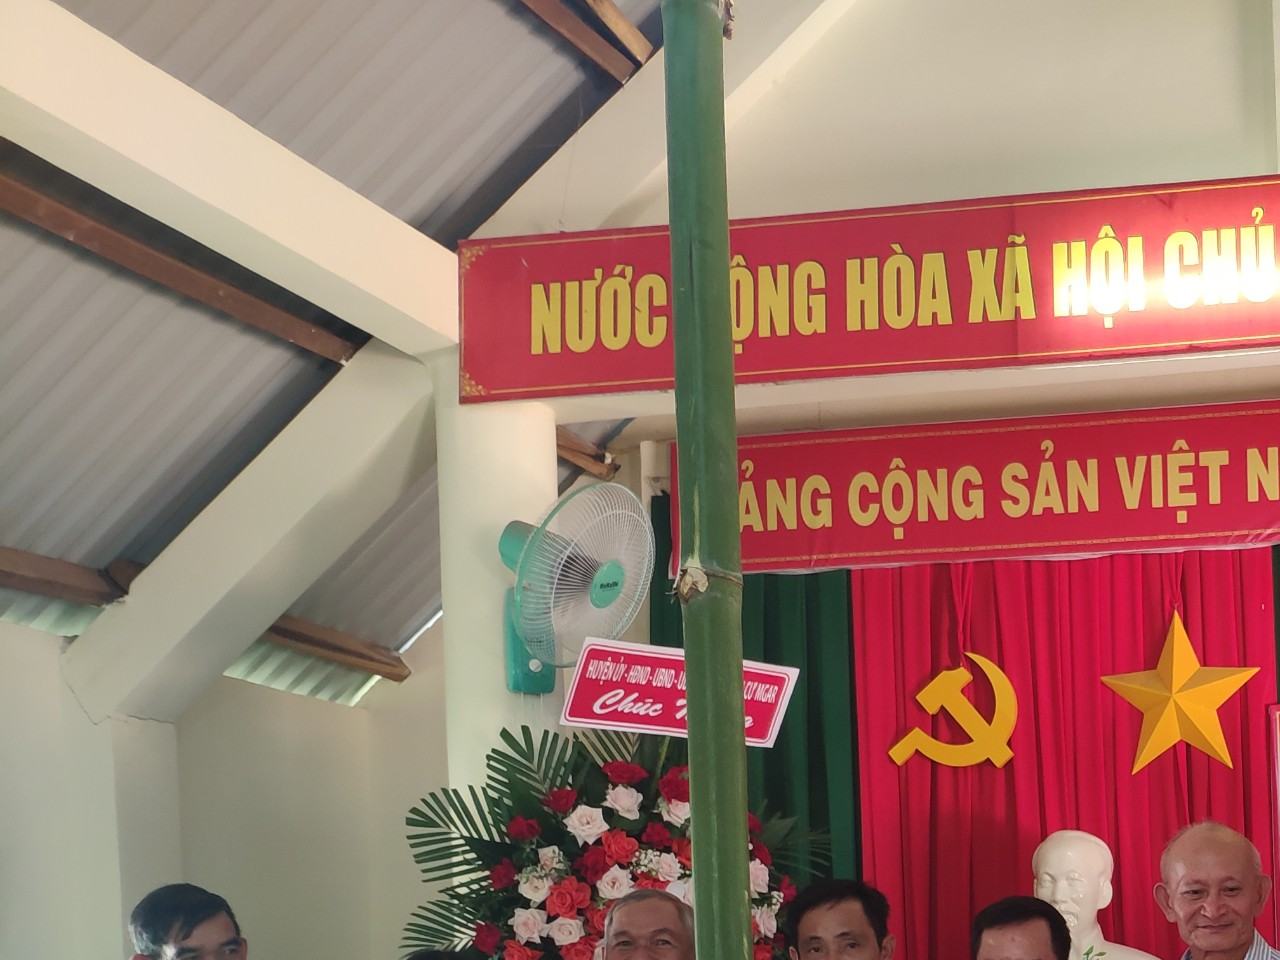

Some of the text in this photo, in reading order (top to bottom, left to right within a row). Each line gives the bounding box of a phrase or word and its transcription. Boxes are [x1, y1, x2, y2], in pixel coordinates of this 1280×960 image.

[530, 264, 668, 355] NƯỚC
[729, 254, 827, 355] ỘNG
[846, 243, 953, 332] HÒA
[966, 234, 1036, 322] XÃ
[1053, 224, 1147, 329] HỘI
[1163, 207, 1278, 310] CHỦ
[739, 460, 833, 534] ẢNG
[848, 457, 985, 540] CỘNG
[1000, 439, 1100, 519] SẢN
[1115, 439, 1230, 524] VIỆT
[586, 656, 614, 685] HUYỆN
[652, 667, 675, 689] UBND
